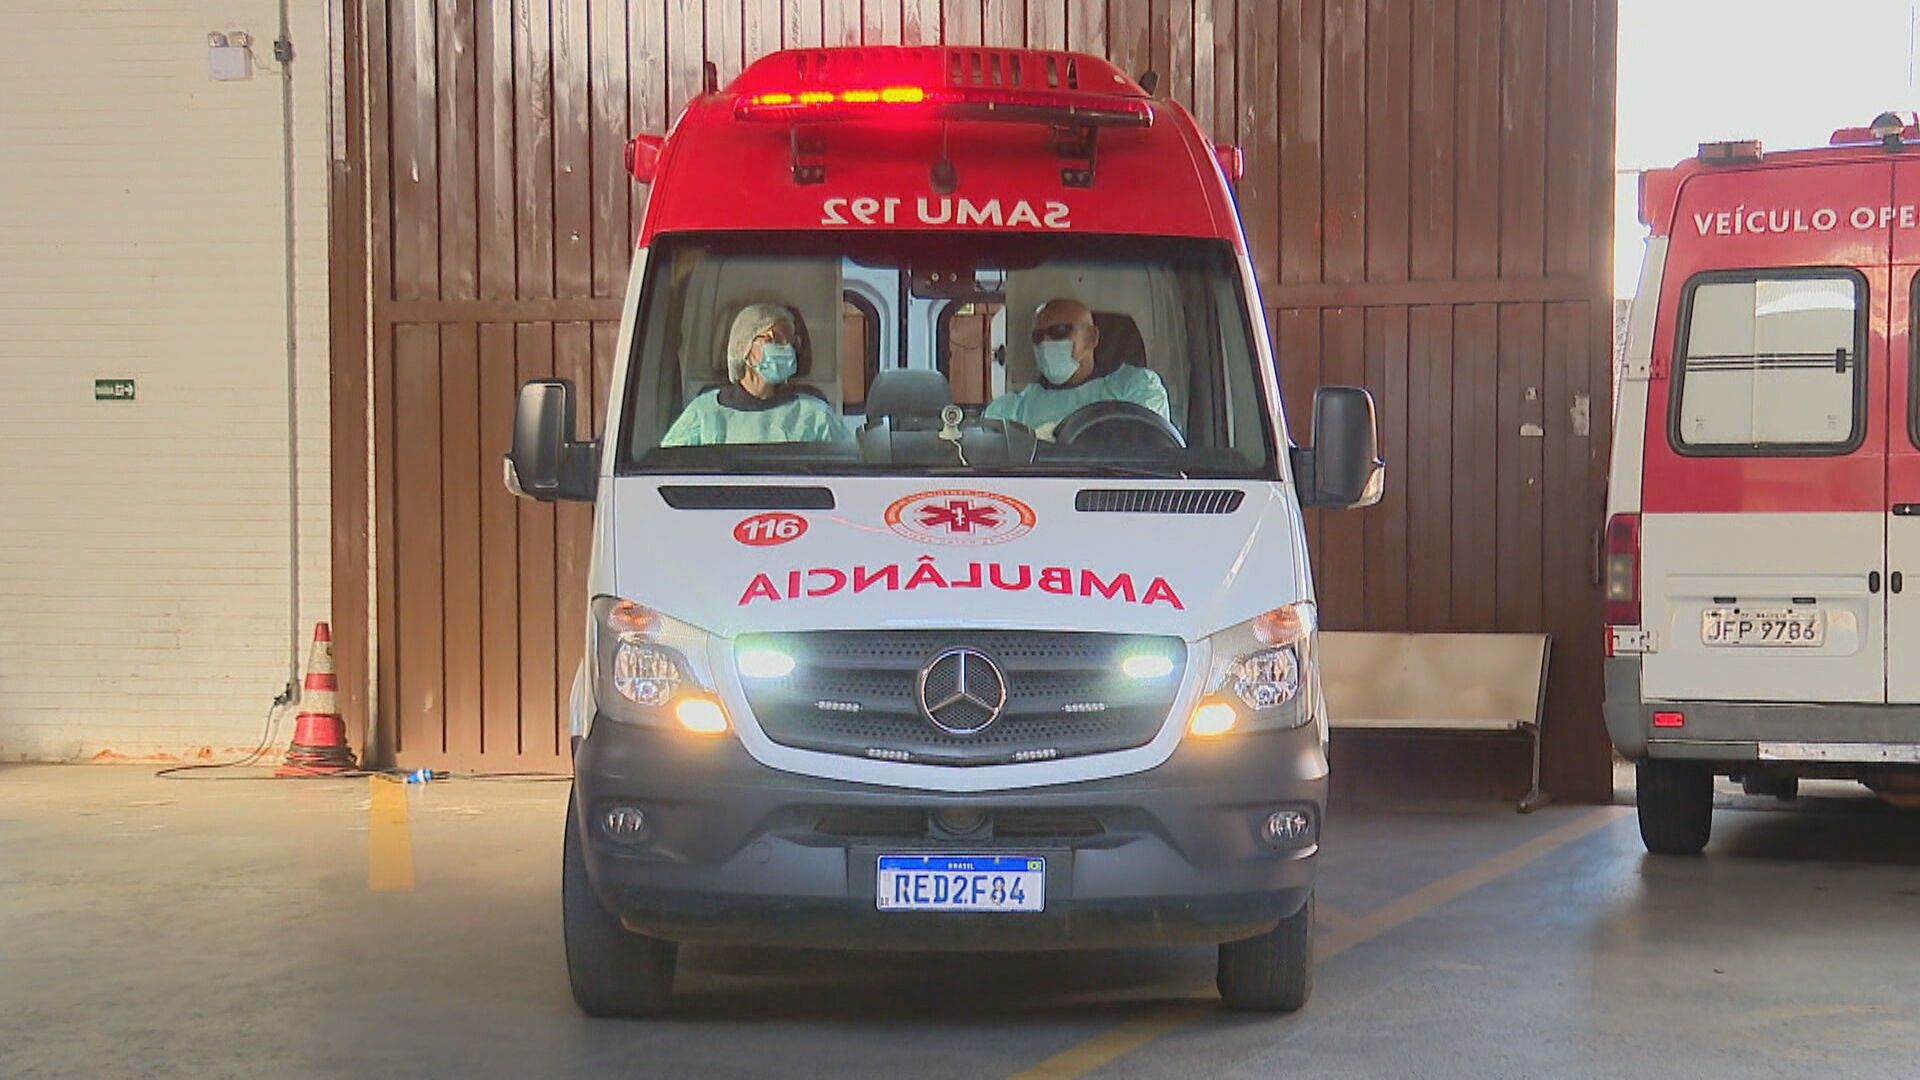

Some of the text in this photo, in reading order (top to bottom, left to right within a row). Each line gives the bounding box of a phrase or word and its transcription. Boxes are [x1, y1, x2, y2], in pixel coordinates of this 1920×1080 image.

[1693, 204, 1920, 236] VEÍCULO OPE
[742, 518, 801, 541] 116
[1708, 618, 1815, 640] JFP 9786
[947, 862, 976, 871] BRASIL
[895, 874, 1026, 905] RED2F84
